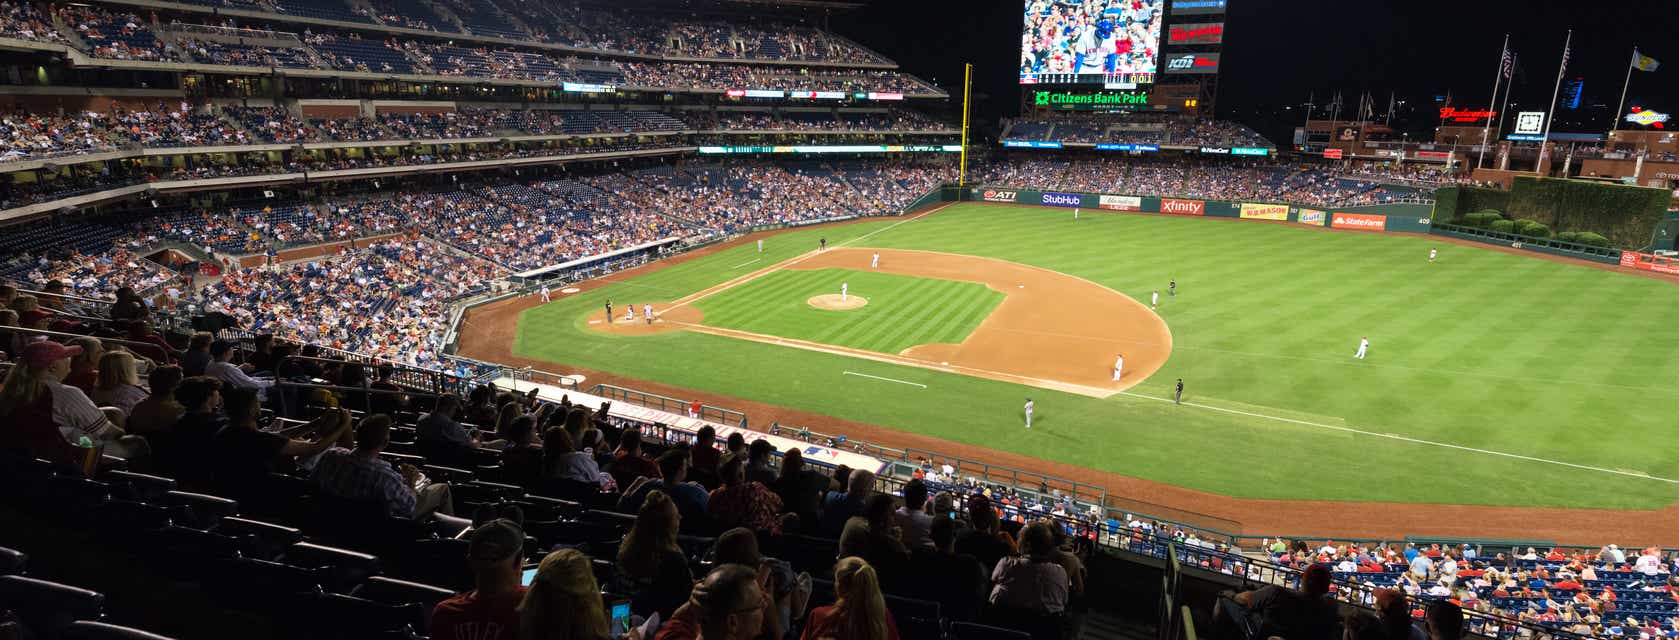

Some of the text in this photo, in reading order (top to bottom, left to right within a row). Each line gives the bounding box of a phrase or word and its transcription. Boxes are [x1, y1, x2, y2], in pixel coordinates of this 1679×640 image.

[1051, 92, 1148, 104] Citizens Bank Park
[996, 191, 1017, 199] ATI
[1042, 194, 1080, 205] StubHub
[1163, 201, 1201, 213] xfinity
[1303, 213, 1321, 221] Gulf
